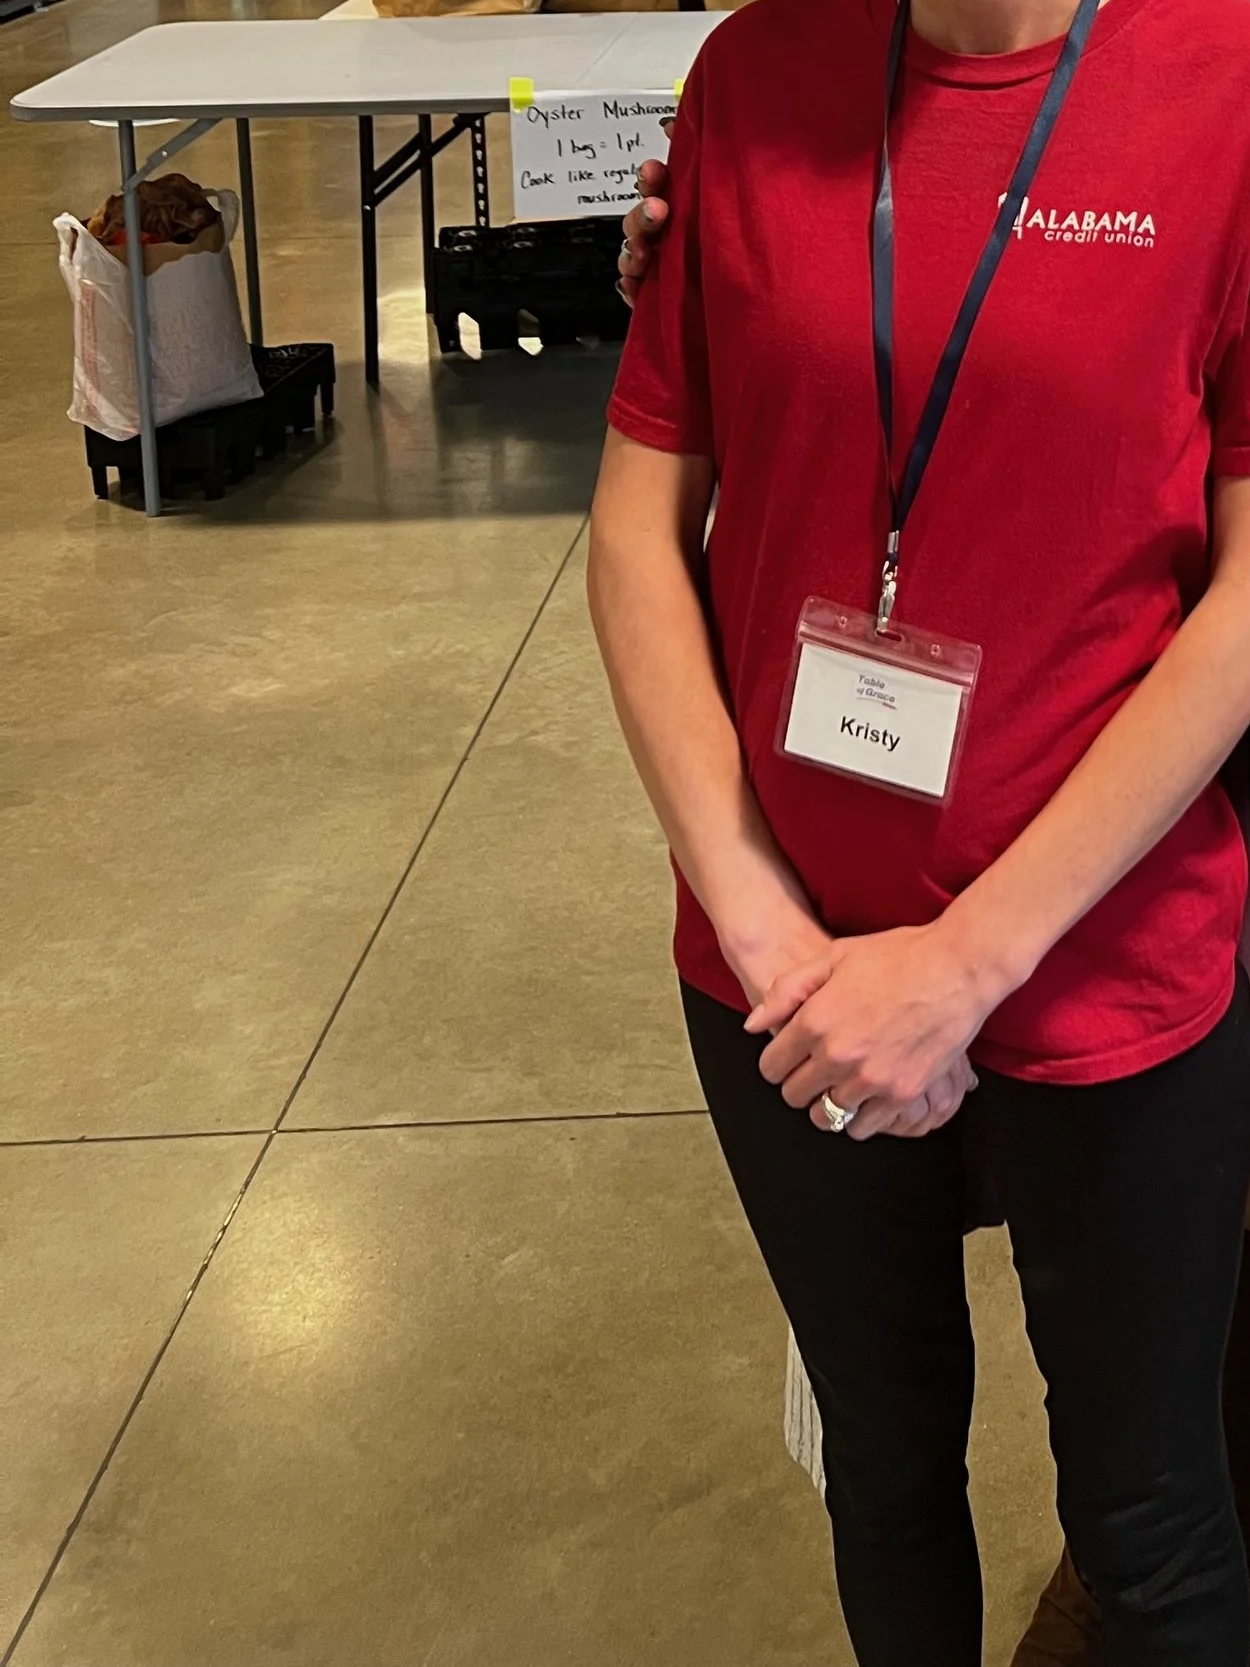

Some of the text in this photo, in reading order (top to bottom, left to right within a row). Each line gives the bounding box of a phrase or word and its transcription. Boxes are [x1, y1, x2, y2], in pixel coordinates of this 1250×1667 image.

[527, 105, 586, 129] Oyster
[569, 139, 596, 159] bag
[521, 170, 555, 190] Cook
[568, 168, 596, 183] like
[1026, 208, 1156, 235] ALABAMA
[1044, 229, 1154, 248] credit union
[858, 673, 885, 689] Table
[865, 687, 895, 703] Grace
[840, 715, 900, 752] Kristy
